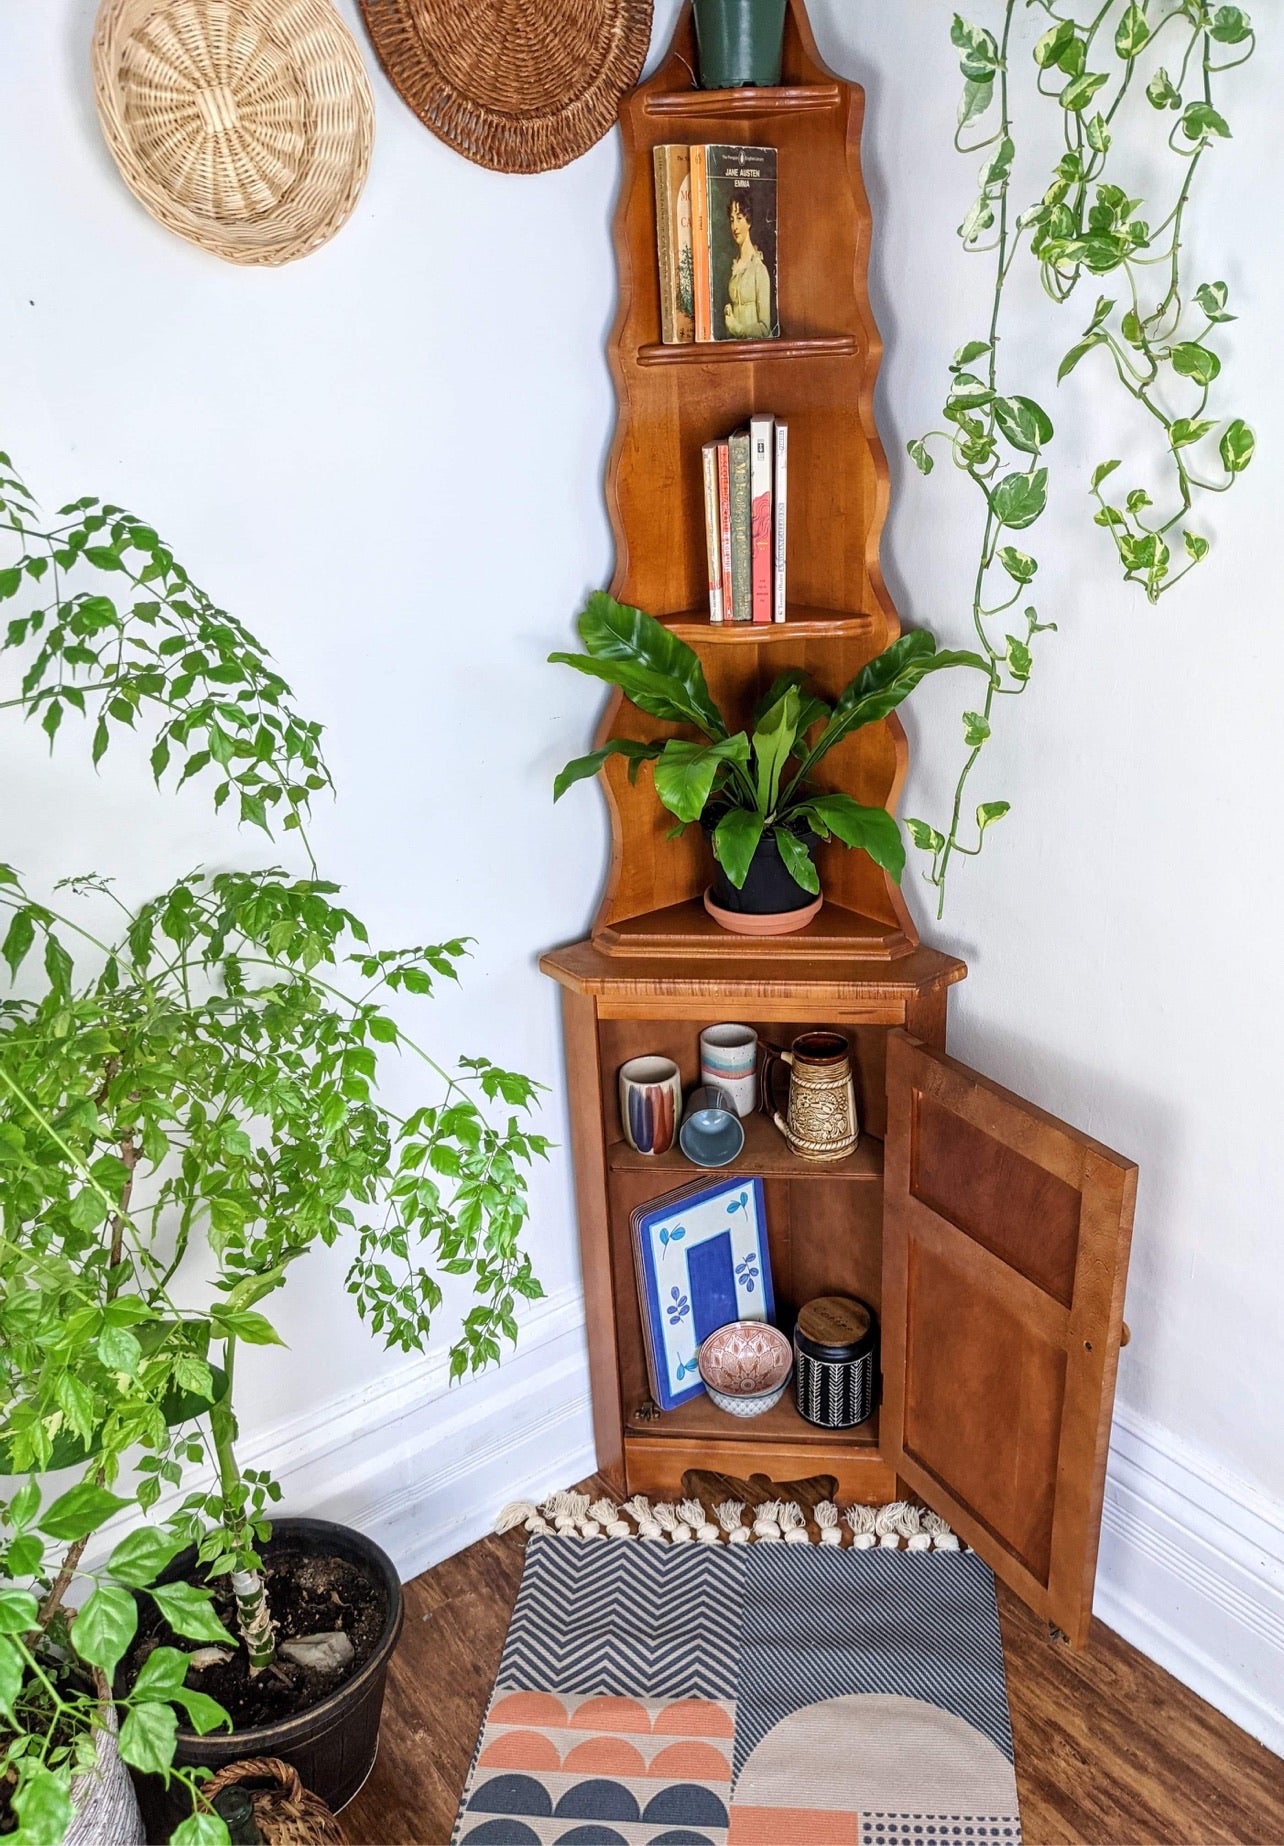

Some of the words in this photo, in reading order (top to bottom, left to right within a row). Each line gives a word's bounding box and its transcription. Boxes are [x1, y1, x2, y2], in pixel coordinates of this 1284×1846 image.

[725, 168, 738, 176] JANE
[740, 169, 760, 178] AUSTEN
[734, 180, 750, 188] EMMA
